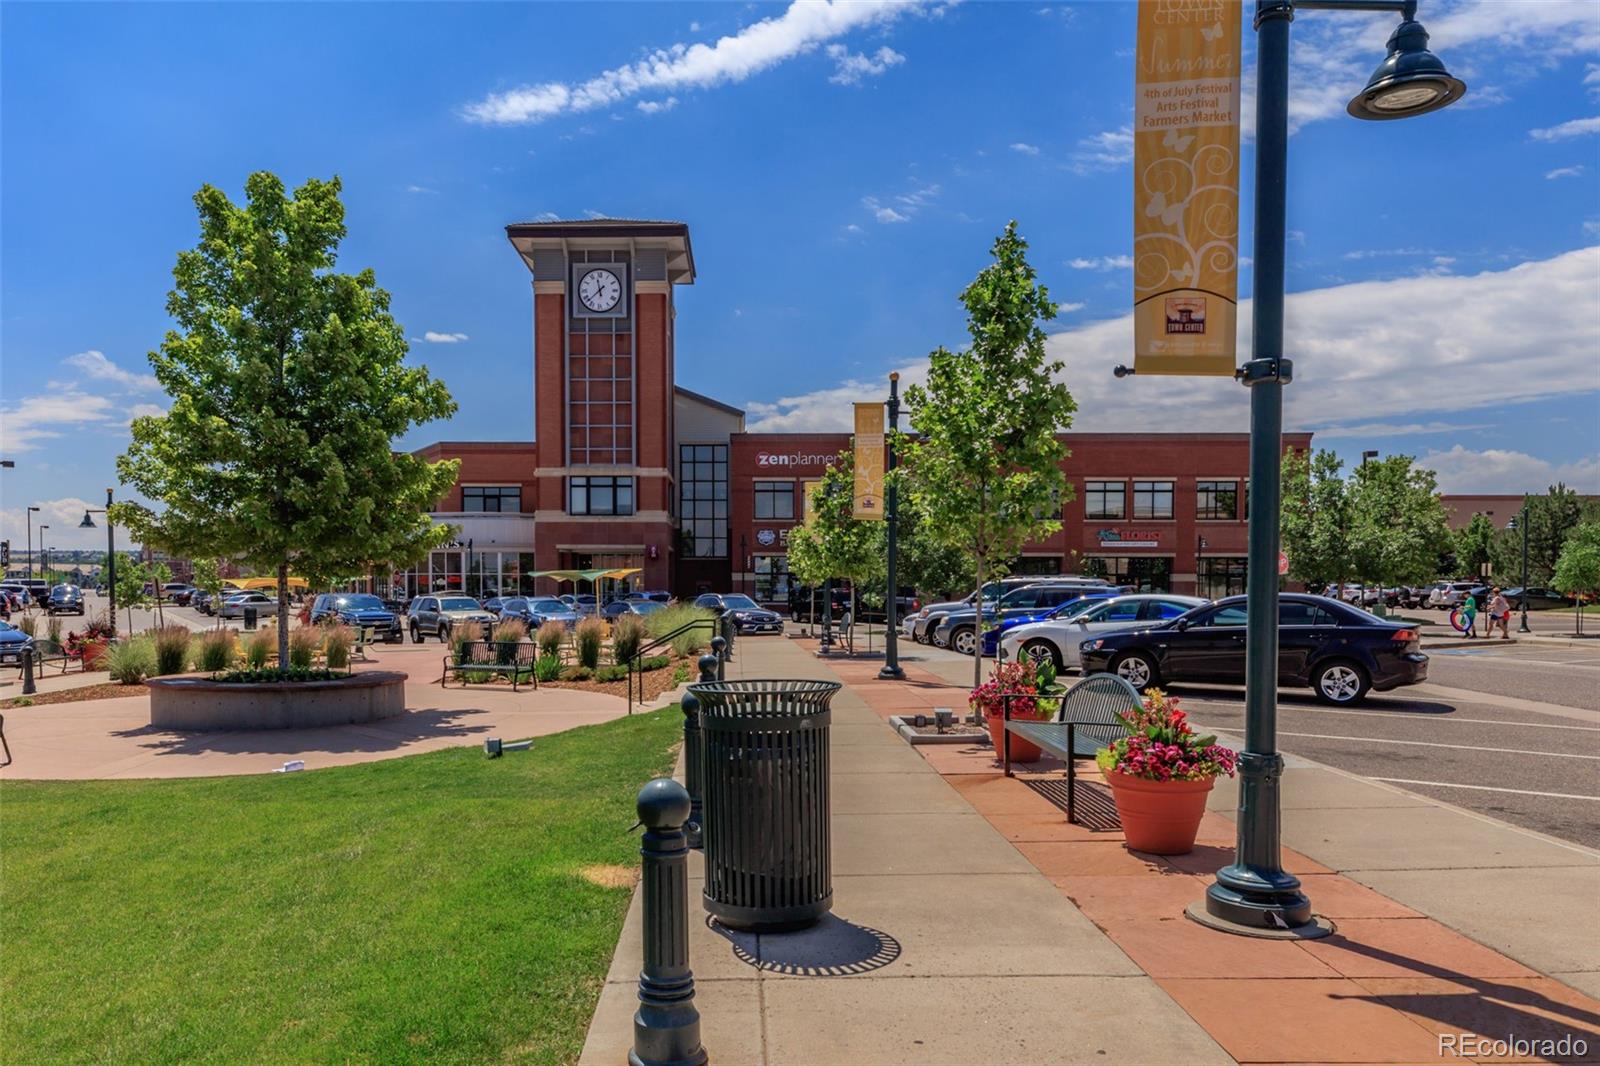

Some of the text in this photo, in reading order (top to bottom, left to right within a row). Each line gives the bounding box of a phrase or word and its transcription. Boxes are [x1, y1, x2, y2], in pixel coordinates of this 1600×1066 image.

[1153, 9, 1225, 25] CENTER
[1144, 82, 1232, 99] 4th of July Festival
[1156, 97, 1219, 112] Arts Festival
[1143, 110, 1232, 127] Farmers Market
[1168, 323, 1204, 332] TOWN CENTER
[1120, 531, 1161, 540] FLORIST
